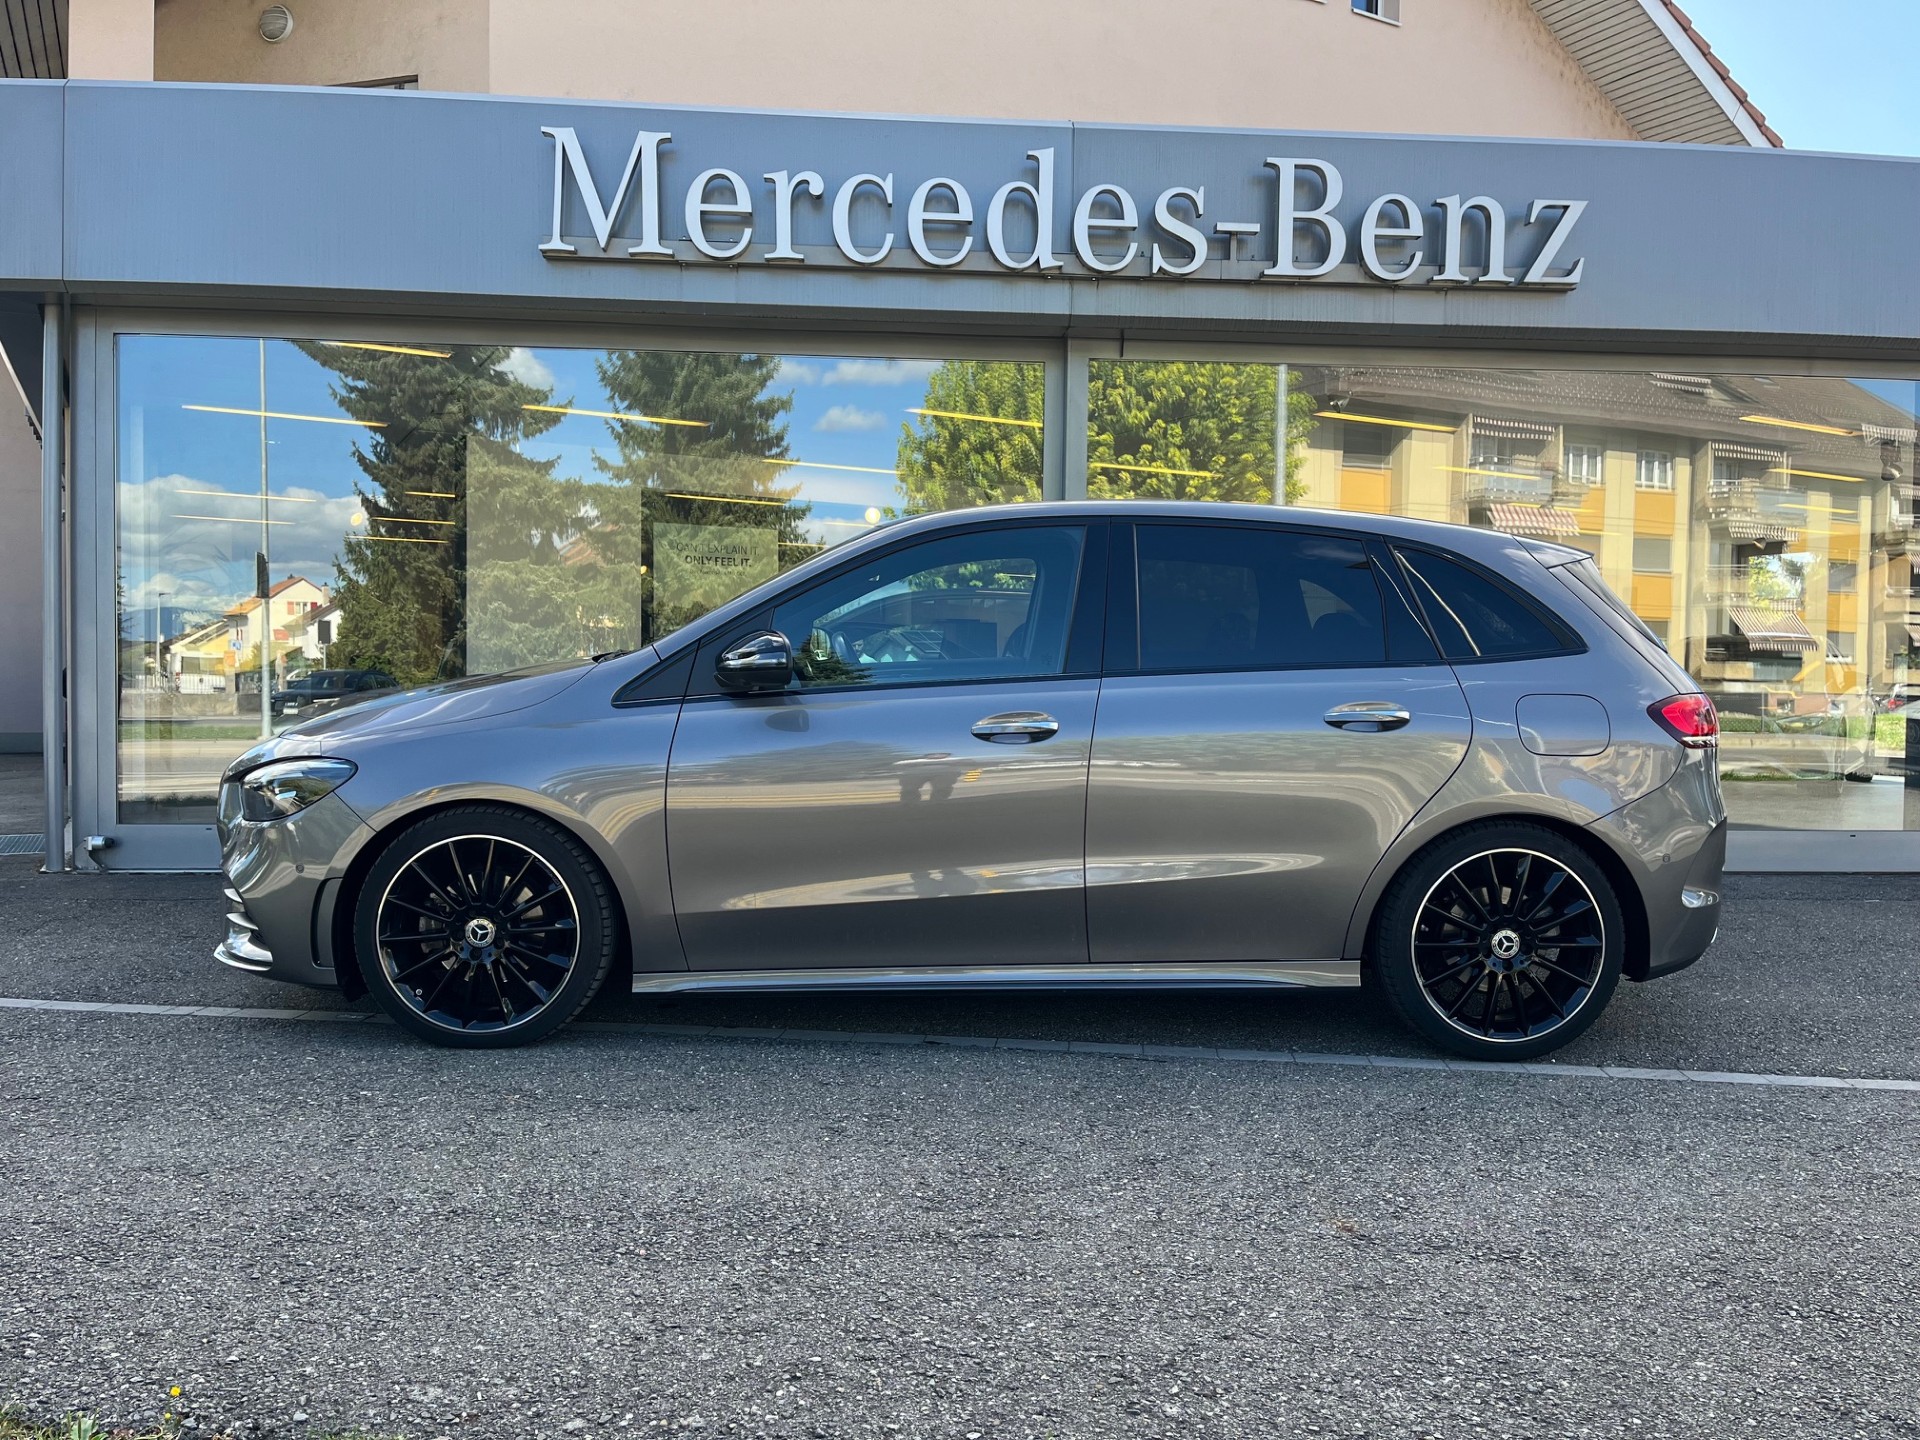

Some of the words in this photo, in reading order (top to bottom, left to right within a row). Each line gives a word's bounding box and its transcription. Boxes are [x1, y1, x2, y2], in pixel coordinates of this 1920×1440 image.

[538, 126, 1589, 284] Mercedes-Benz
[707, 544, 748, 555] EXPLAIN
[684, 554, 713, 566] ONLY
[714, 556, 739, 567] FEEL
